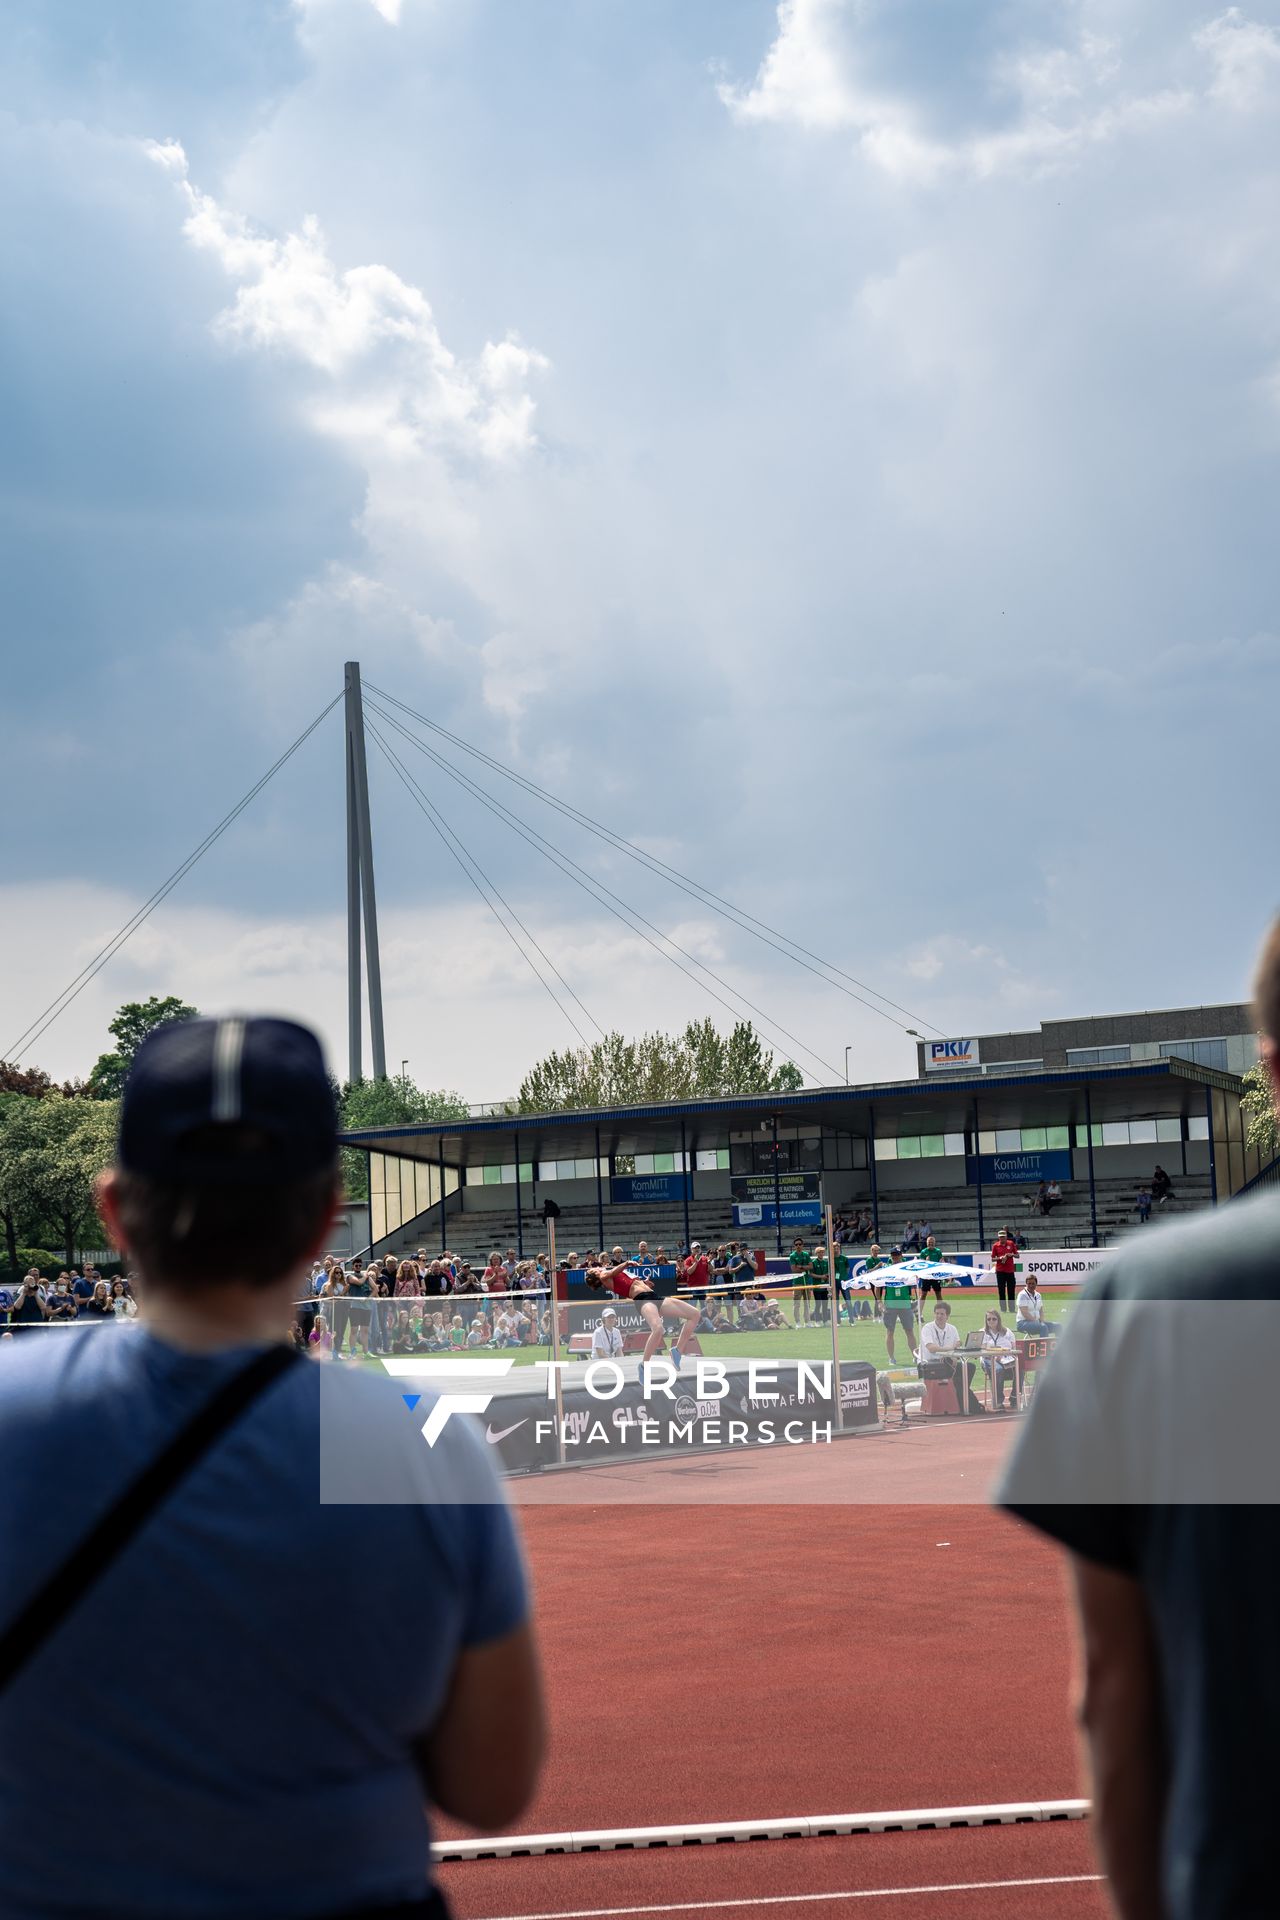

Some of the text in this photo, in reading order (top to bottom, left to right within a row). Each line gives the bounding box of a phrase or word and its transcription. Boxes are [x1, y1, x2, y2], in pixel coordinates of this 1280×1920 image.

[931, 1041, 971, 1058] PKV
[993, 1155, 1041, 1171] KomMITT
[995, 1171, 1042, 1180] 100% Stadtwerke
[631, 1178, 668, 1191] KomMITT
[849, 1382, 868, 1392] PLAN
